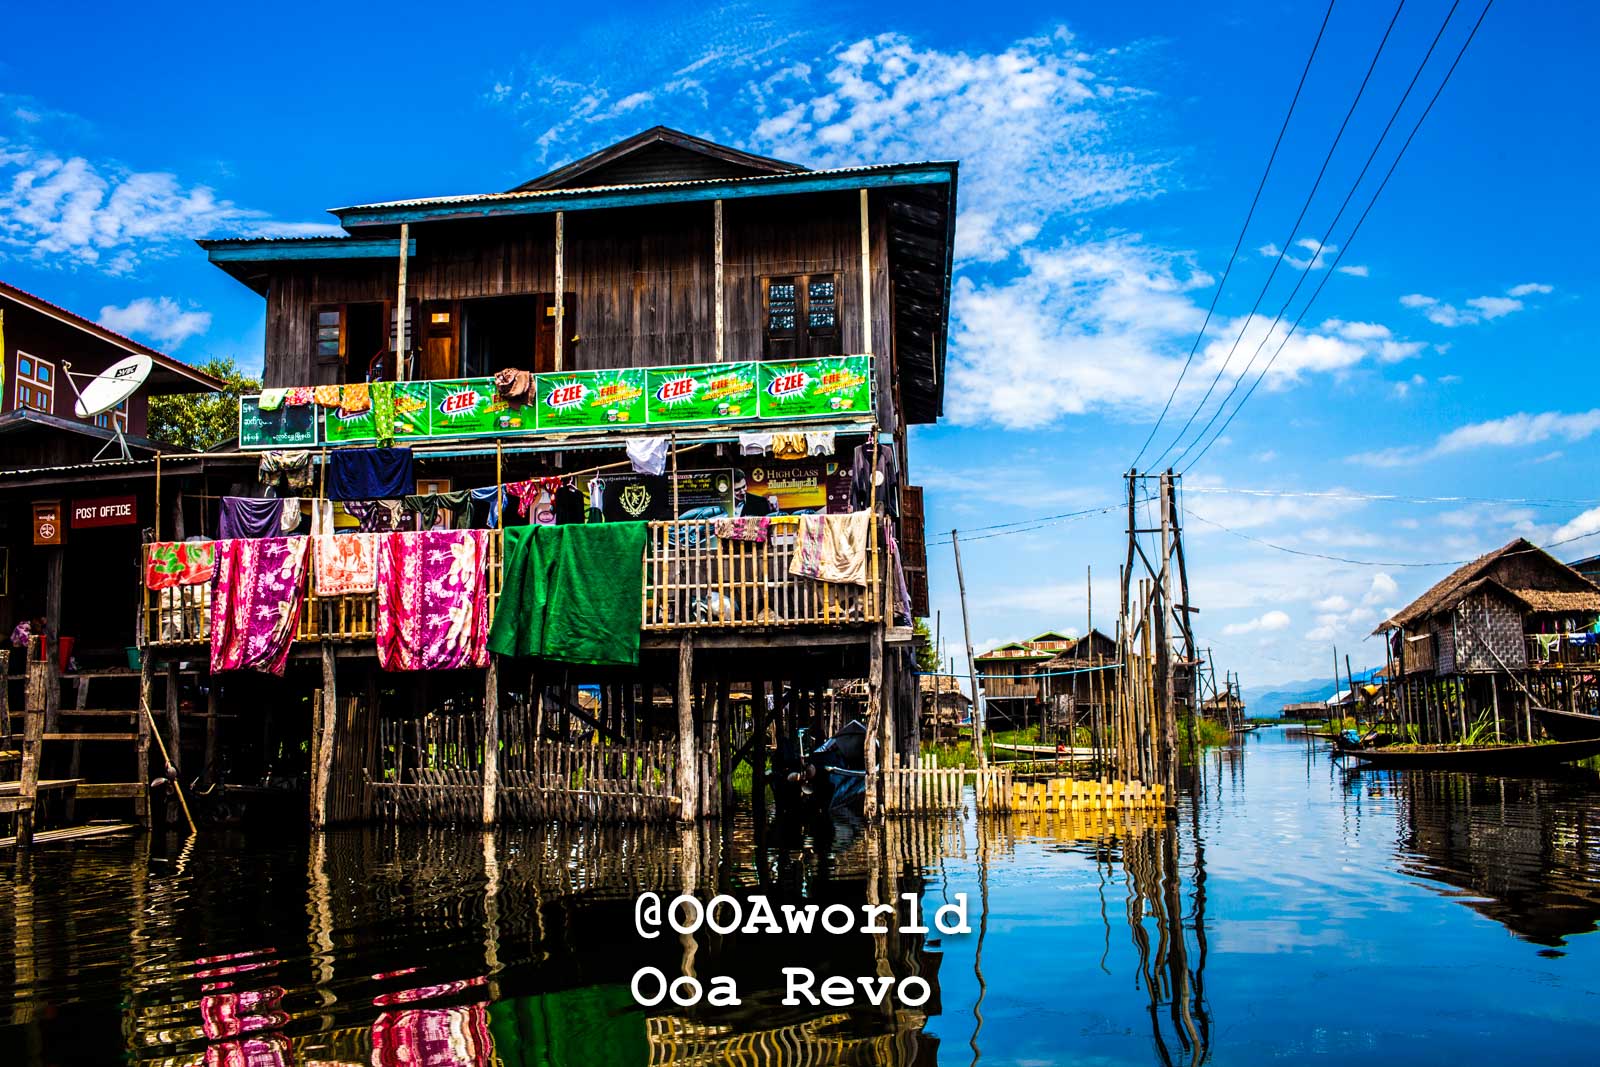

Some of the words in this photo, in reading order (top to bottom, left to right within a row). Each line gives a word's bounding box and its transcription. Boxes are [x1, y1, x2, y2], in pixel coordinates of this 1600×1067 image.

[663, 378, 693, 399] E-ZEE
[774, 373, 804, 393] E-ZEE
[446, 391, 475, 411] E-ZEE
[553, 385, 582, 404] E-ZEE
[767, 469, 791, 479] HIGH
[792, 468, 819, 478] CLASS
[76, 507, 97, 519] POST
[100, 504, 131, 517] OFFICE
